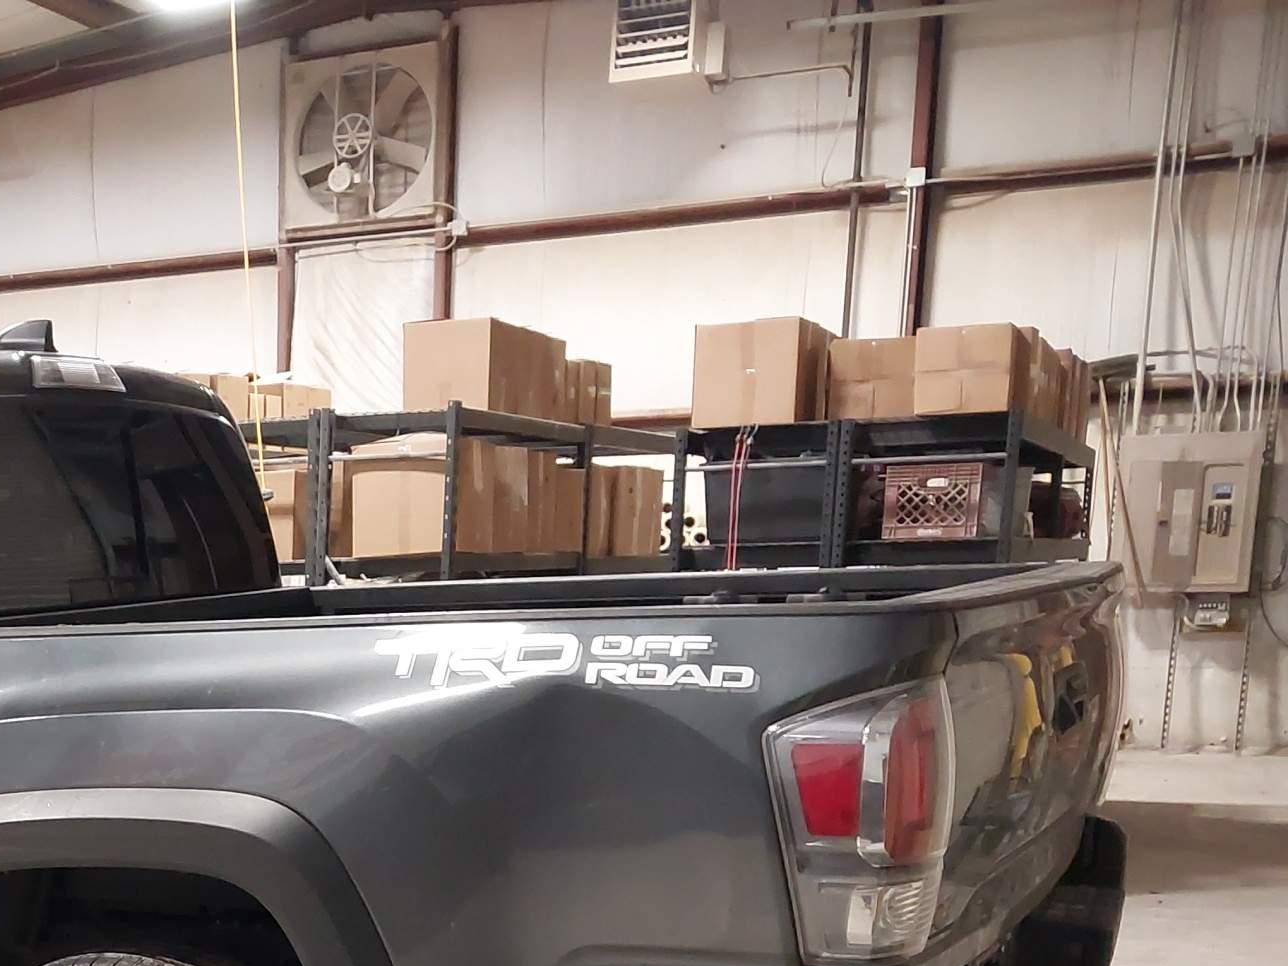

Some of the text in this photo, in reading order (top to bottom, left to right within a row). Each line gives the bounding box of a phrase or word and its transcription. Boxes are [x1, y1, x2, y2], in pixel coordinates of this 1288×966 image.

[375, 632, 582, 688] TRD
[590, 634, 716, 660] OFF
[584, 662, 760, 692] ROAD
